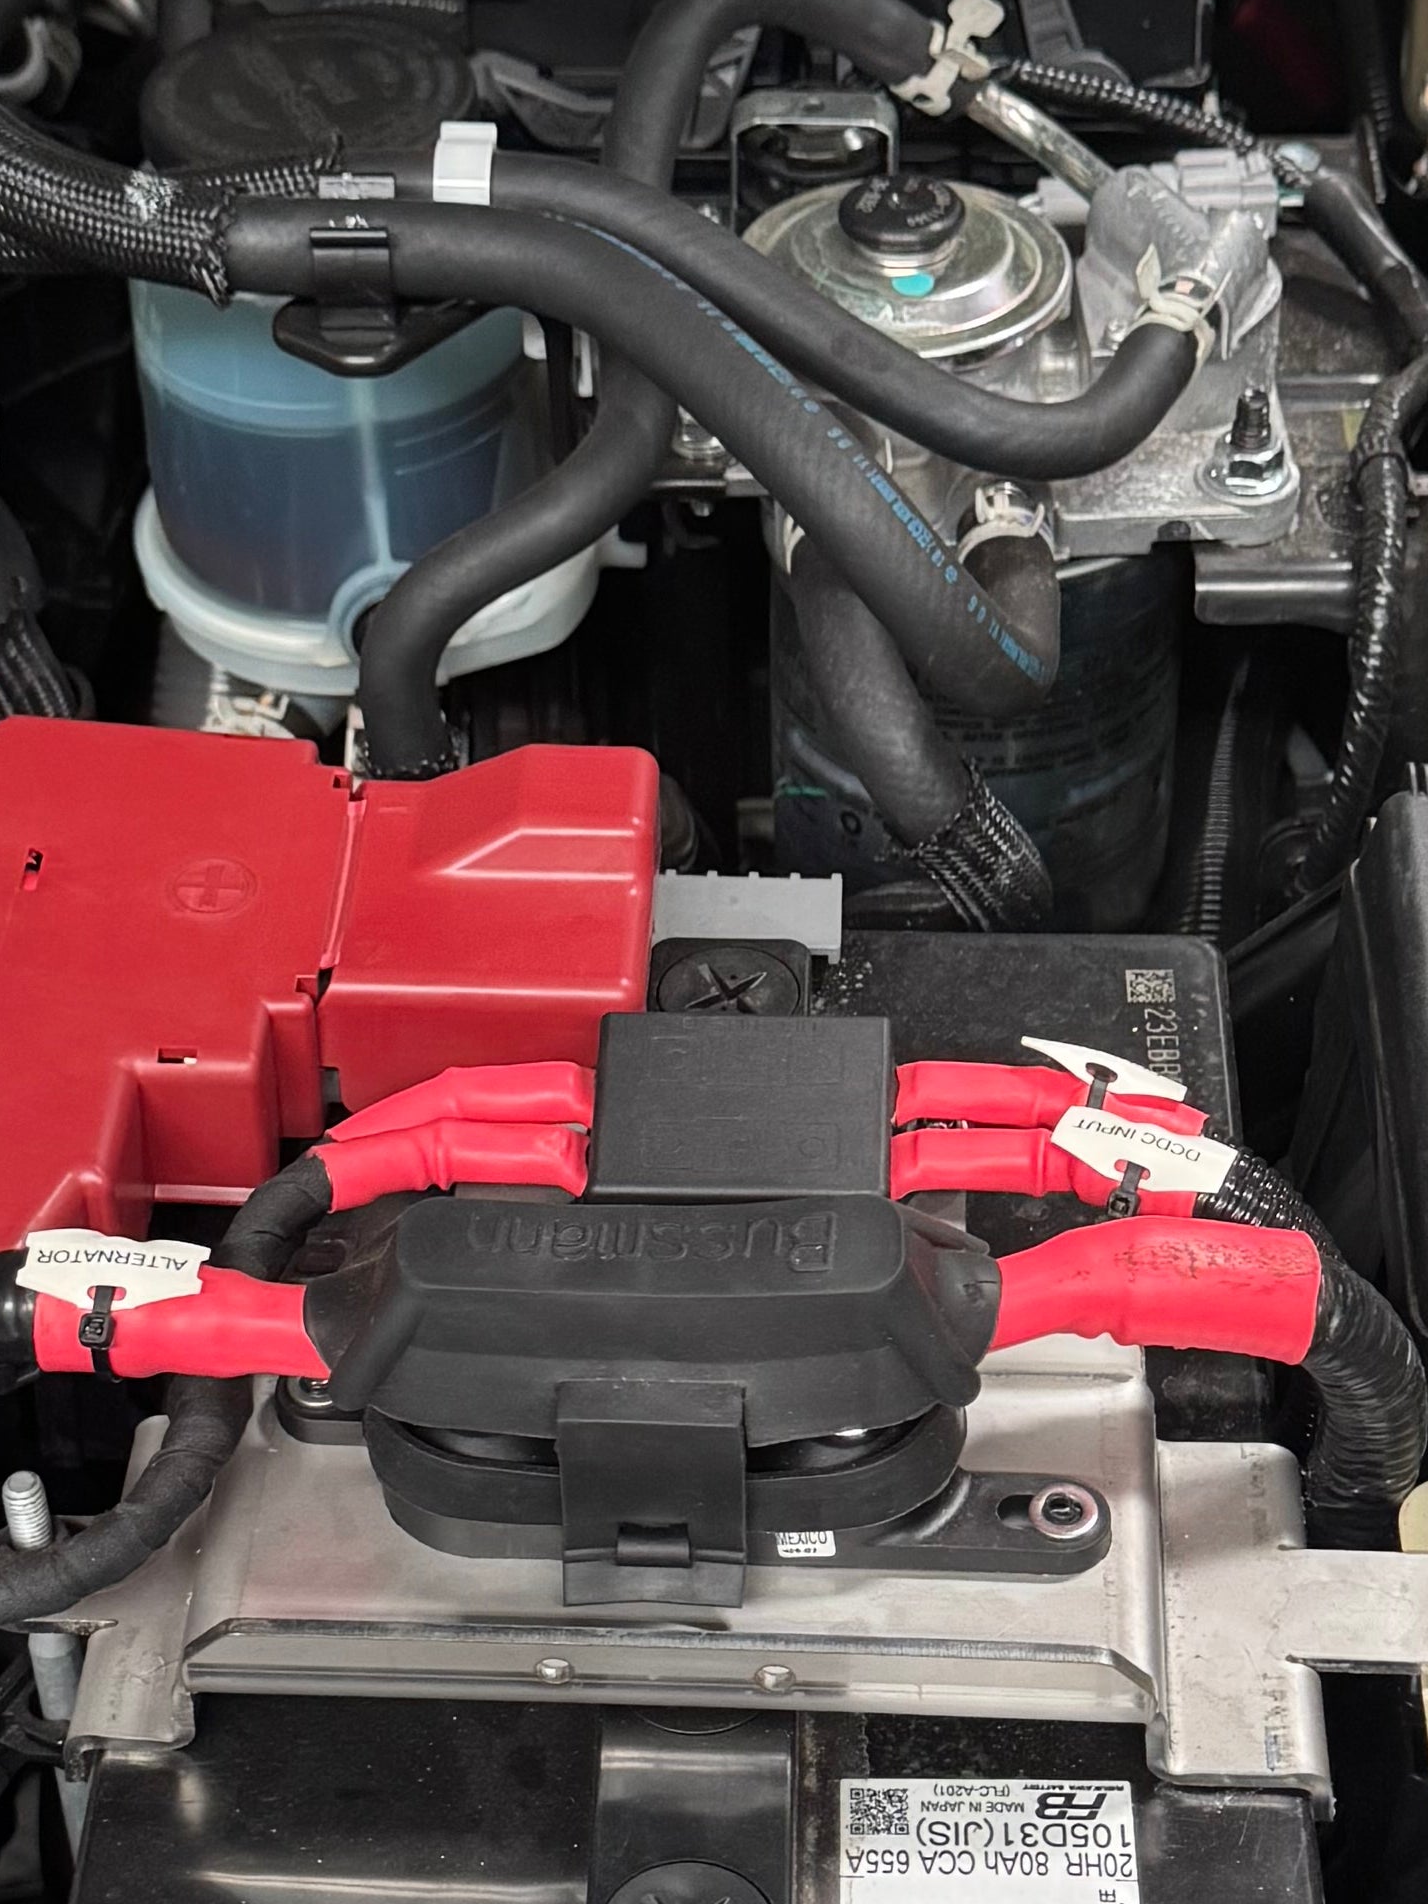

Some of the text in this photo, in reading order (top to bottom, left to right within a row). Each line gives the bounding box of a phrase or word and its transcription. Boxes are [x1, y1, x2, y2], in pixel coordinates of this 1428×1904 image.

[1145, 1008, 1181, 1080] 23EBB
[1072, 1118, 1201, 1162] DCDC INPUT
[466, 1211, 838, 1275] Bussmann
[37, 1250, 188, 1271] ALTERNATOR
[934, 1784, 1010, 1796] (FLC-A201)
[921, 1801, 1024, 1813] MADE IN JAPAN
[916, 1818, 1131, 1848] 105D31(JIS)
[846, 1849, 1132, 1877] 20HR 80Ah CCA 655A
